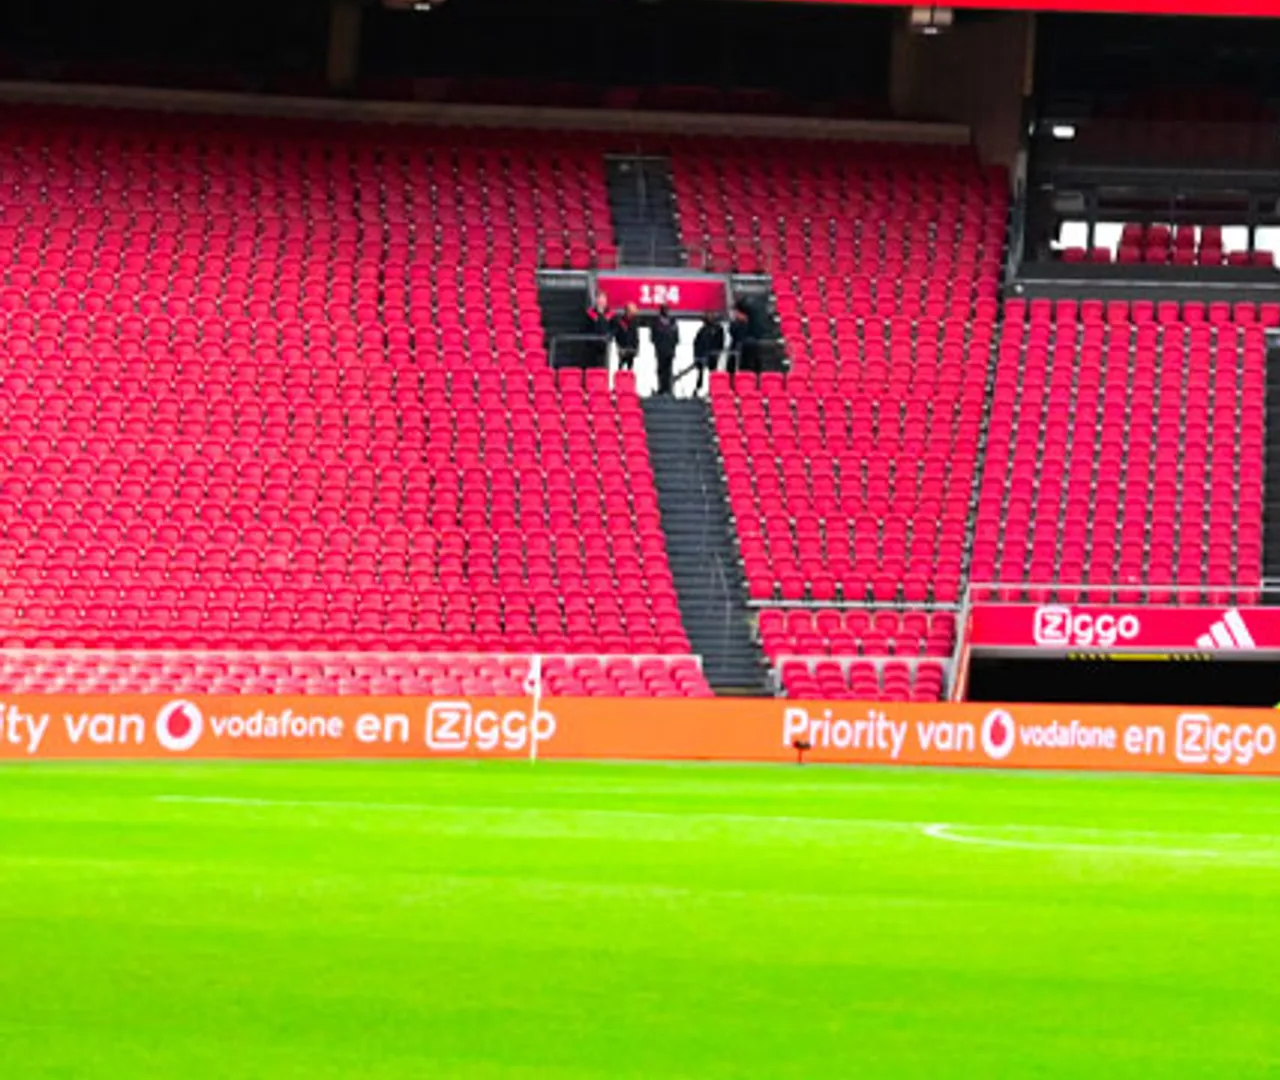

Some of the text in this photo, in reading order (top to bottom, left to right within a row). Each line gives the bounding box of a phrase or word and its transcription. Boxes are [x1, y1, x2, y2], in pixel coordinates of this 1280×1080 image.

[640, 284, 680, 305] 124
[1033, 606, 1140, 645] Ziggo
[63, 713, 146, 744] van
[209, 708, 344, 738] vodafone
[354, 713, 410, 743] en
[425, 700, 557, 751] Ziggo
[782, 707, 1277, 766] Priority van vodafone en Ziggo
